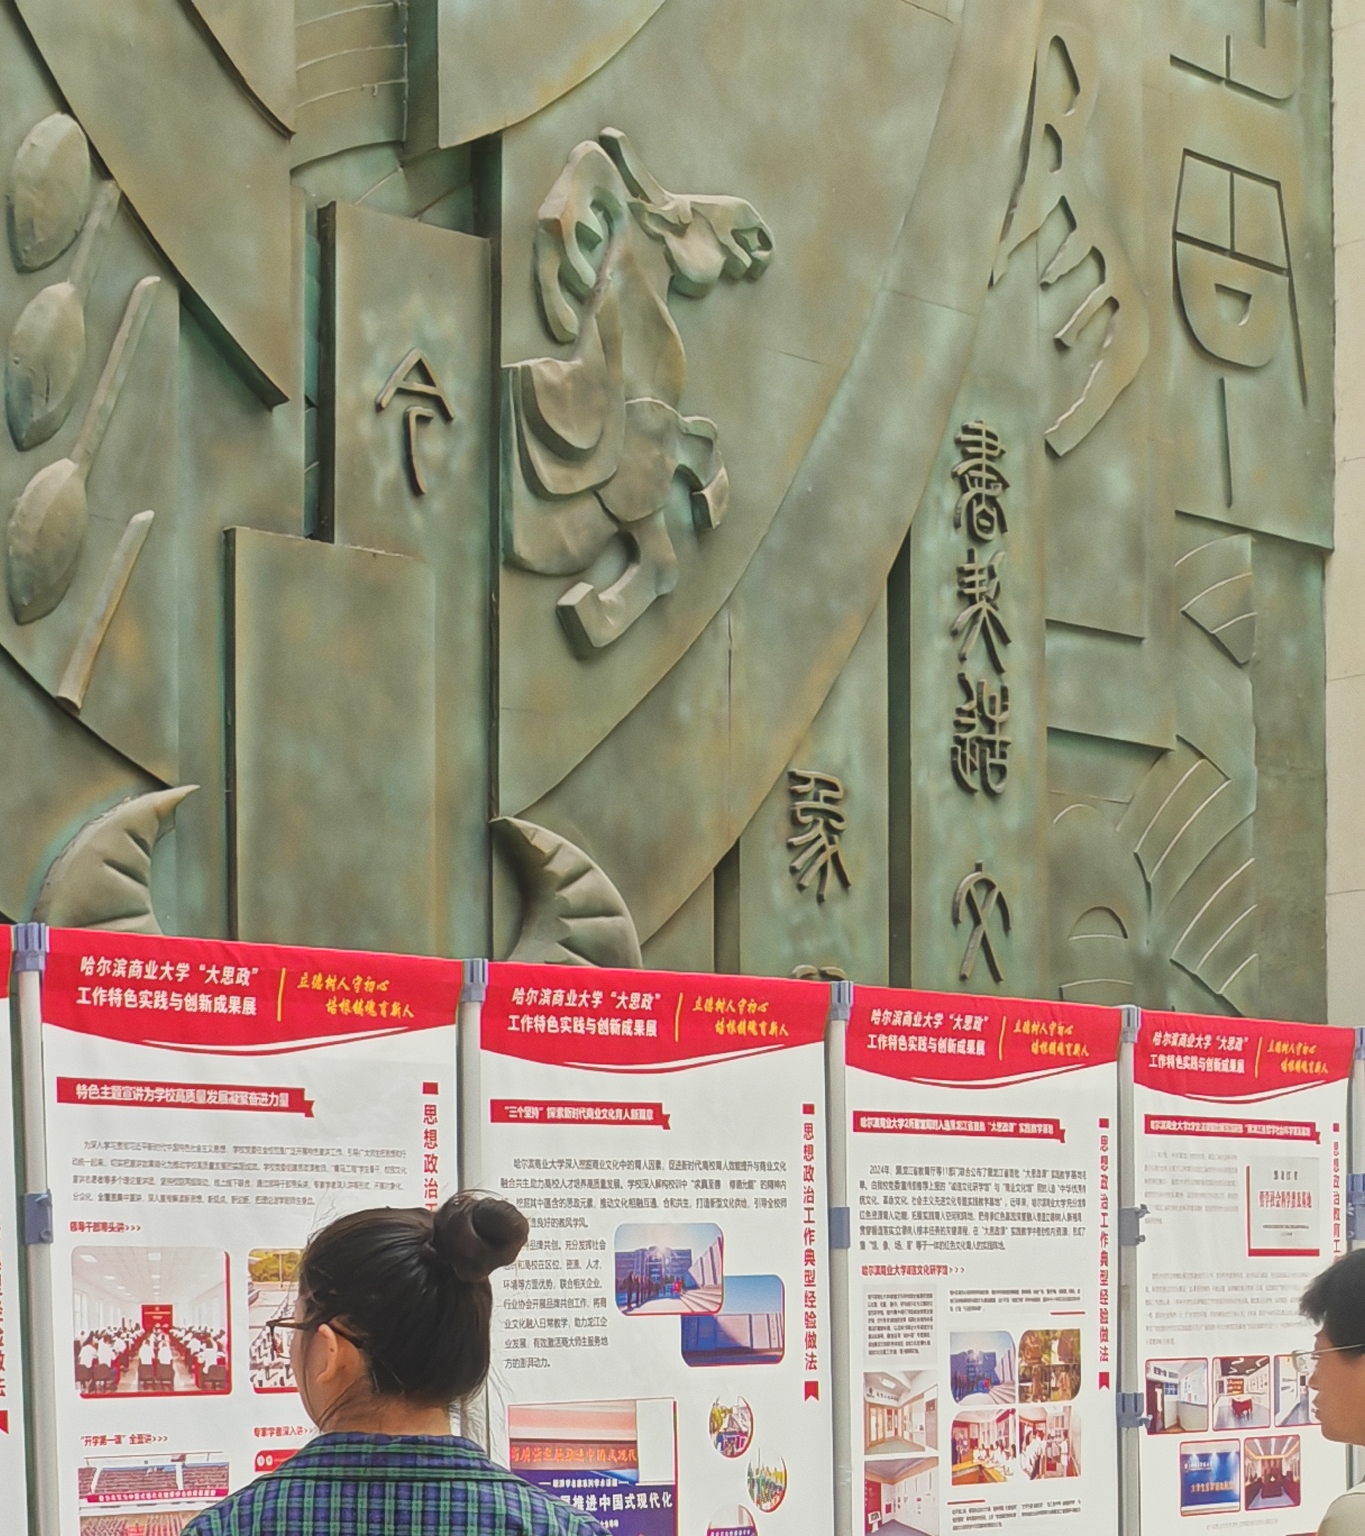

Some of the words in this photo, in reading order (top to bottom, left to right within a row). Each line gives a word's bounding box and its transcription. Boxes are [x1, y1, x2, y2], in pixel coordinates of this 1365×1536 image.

[80, 955, 258, 988] 哈尔滨商业大学“大思政”
[76, 986, 257, 1016] 工作特色实践与创新成果展
[512, 987, 662, 1011] 哈尔滨商业大学“大思政”
[507, 1014, 658, 1038] 工作特色实践与创新成果展
[867, 1034, 986, 1056] 工作特色实践与创新成果展
[802, 1123, 818, 1371] 思想政治工作典型经验做法
